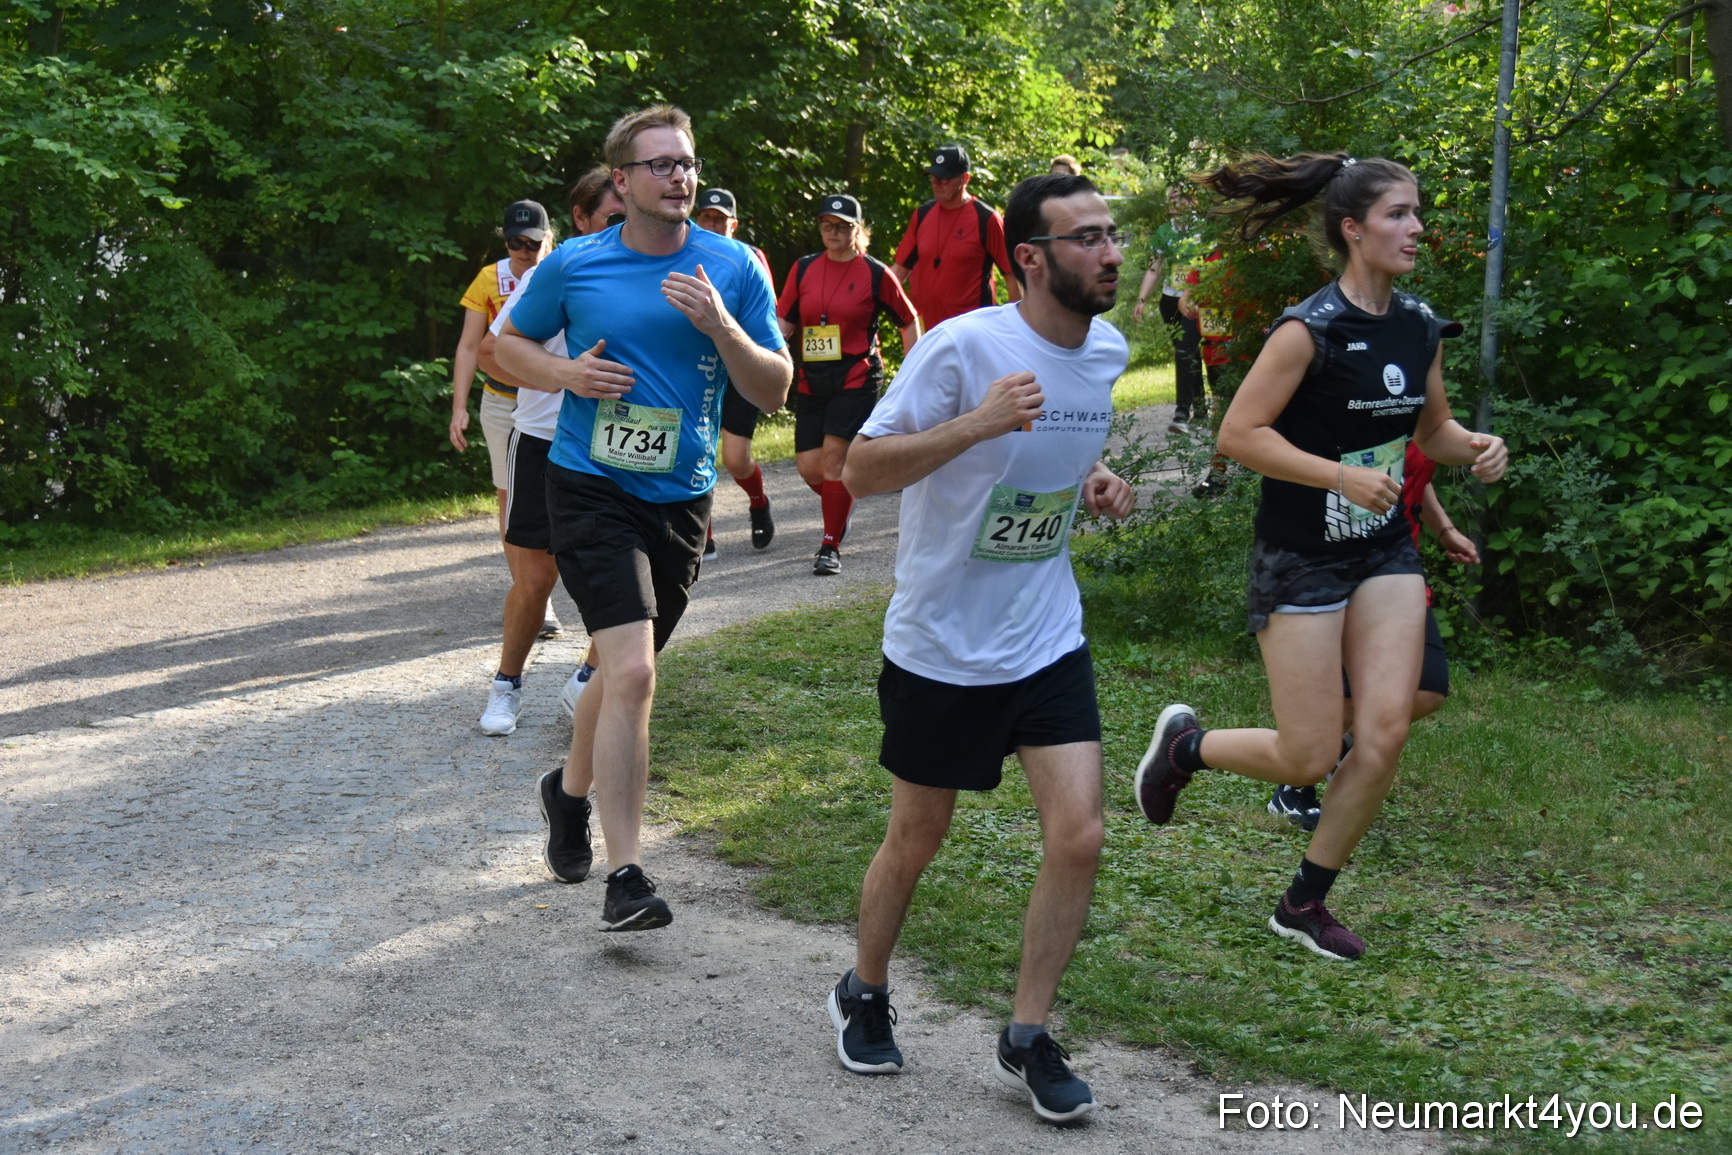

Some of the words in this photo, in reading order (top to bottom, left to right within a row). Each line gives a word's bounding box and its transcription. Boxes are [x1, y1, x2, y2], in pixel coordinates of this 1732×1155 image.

[805, 337, 833, 351] 2331
[1346, 342, 1368, 351] JAKO
[604, 423, 667, 455] 1734
[608, 448, 626, 457] Maier
[628, 452, 657, 461] Willibald
[990, 515, 1062, 543] 2140
